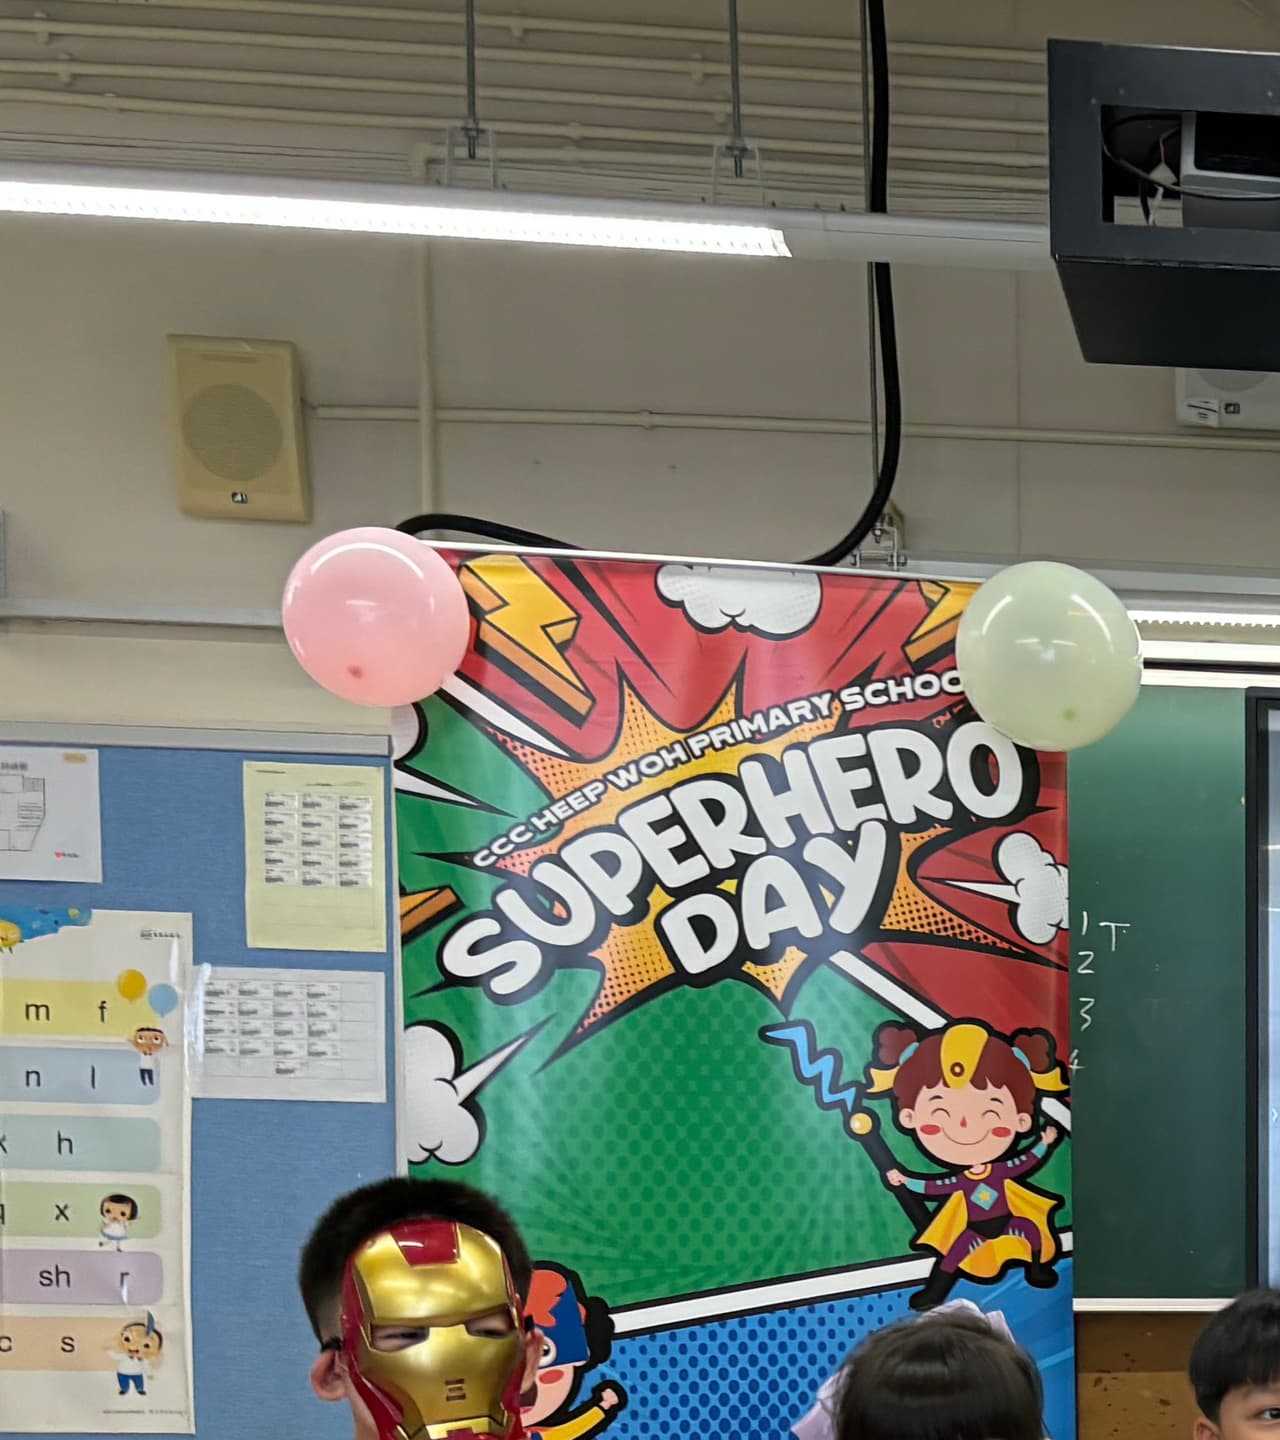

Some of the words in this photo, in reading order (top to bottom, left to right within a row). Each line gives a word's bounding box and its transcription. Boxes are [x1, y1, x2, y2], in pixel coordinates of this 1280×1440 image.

[472, 824, 534, 868] CCC
[530, 781, 607, 832] HEEP
[606, 742, 688, 790] WOH
[688, 692, 834, 758] PRIMARY
[839, 669, 964, 711] SCHOO
[441, 721, 1023, 996] SUPERHERO
[659, 820, 887, 975] DAY
[1077, 951, 1095, 974] 2
[25, 1002, 50, 1021] m
[98, 1000, 108, 1023] f
[1079, 997, 1095, 1031] 3
[25, 1069, 41, 1088] n
[57, 1130, 73, 1155] h
[55, 1203, 70, 1222] x
[39, 1264, 71, 1289] sh
[61, 1335, 75, 1353] s
